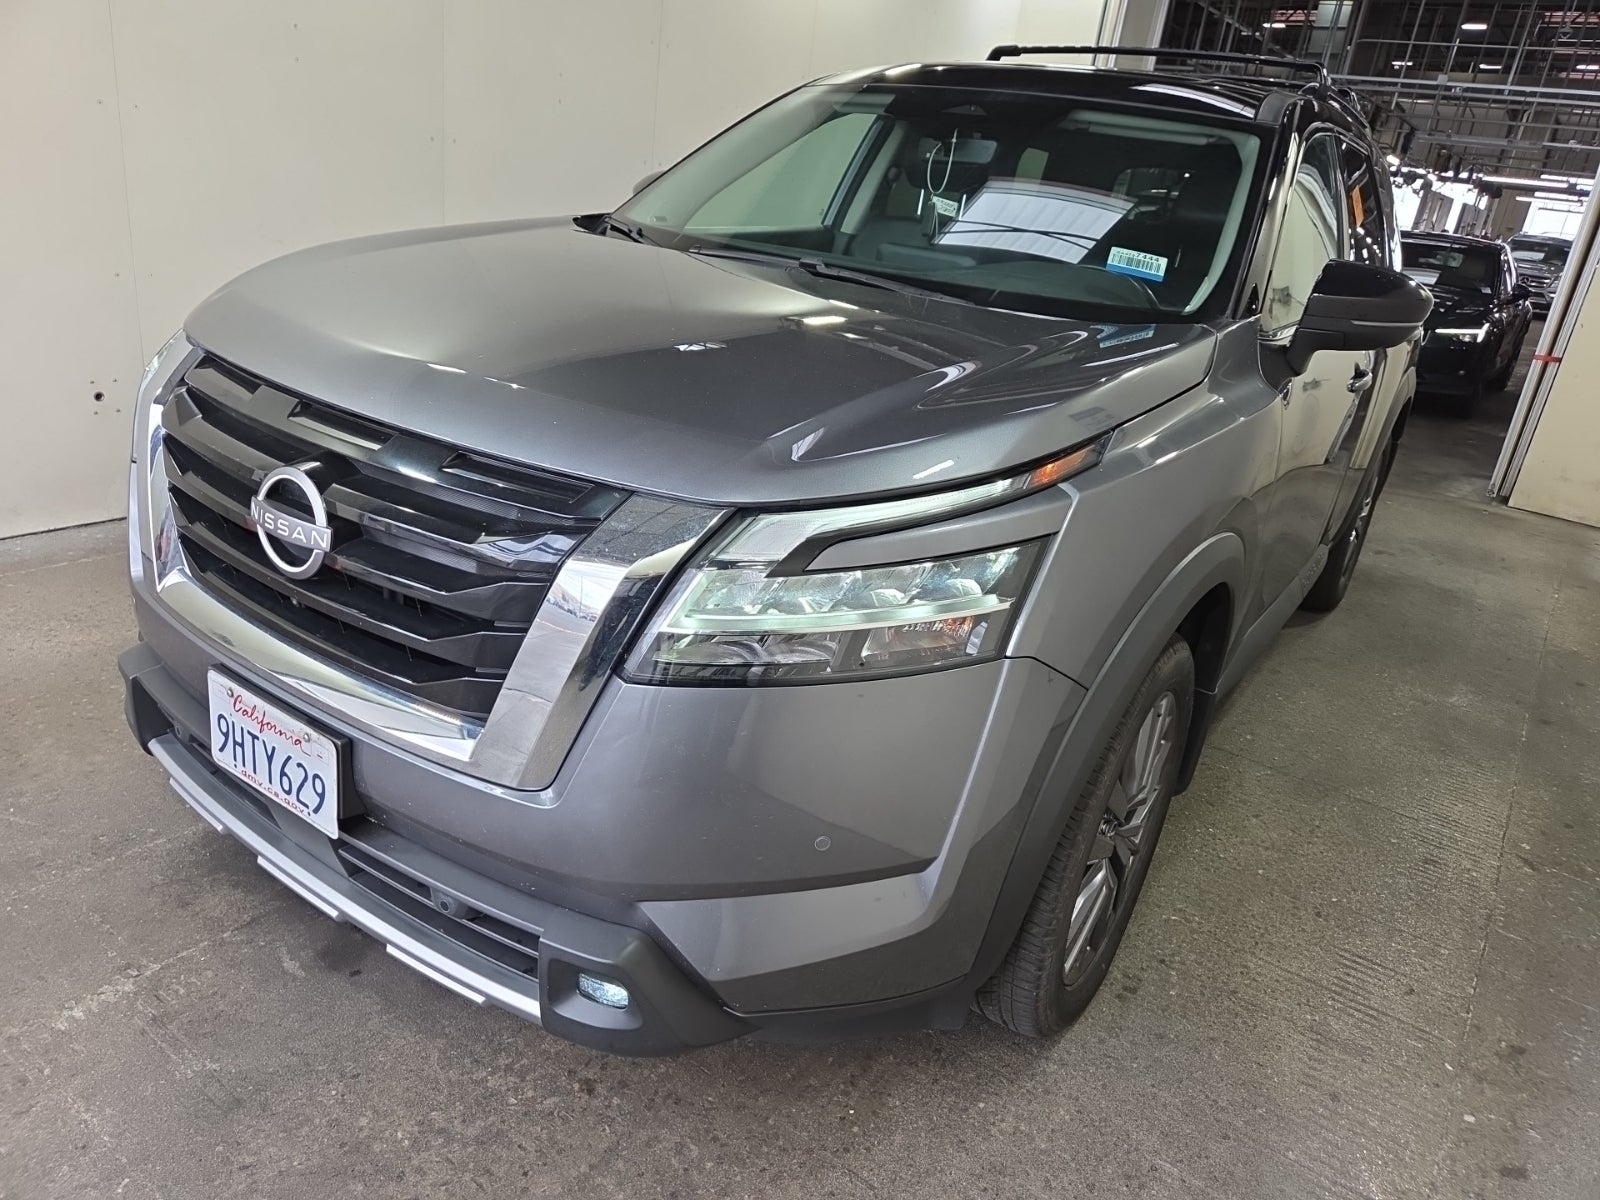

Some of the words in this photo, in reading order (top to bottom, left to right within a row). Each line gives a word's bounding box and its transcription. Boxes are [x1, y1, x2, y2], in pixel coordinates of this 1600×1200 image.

[251, 500, 327, 548] NISSAN
[232, 694, 311, 757] California
[217, 713, 326, 815] 9HTY629
